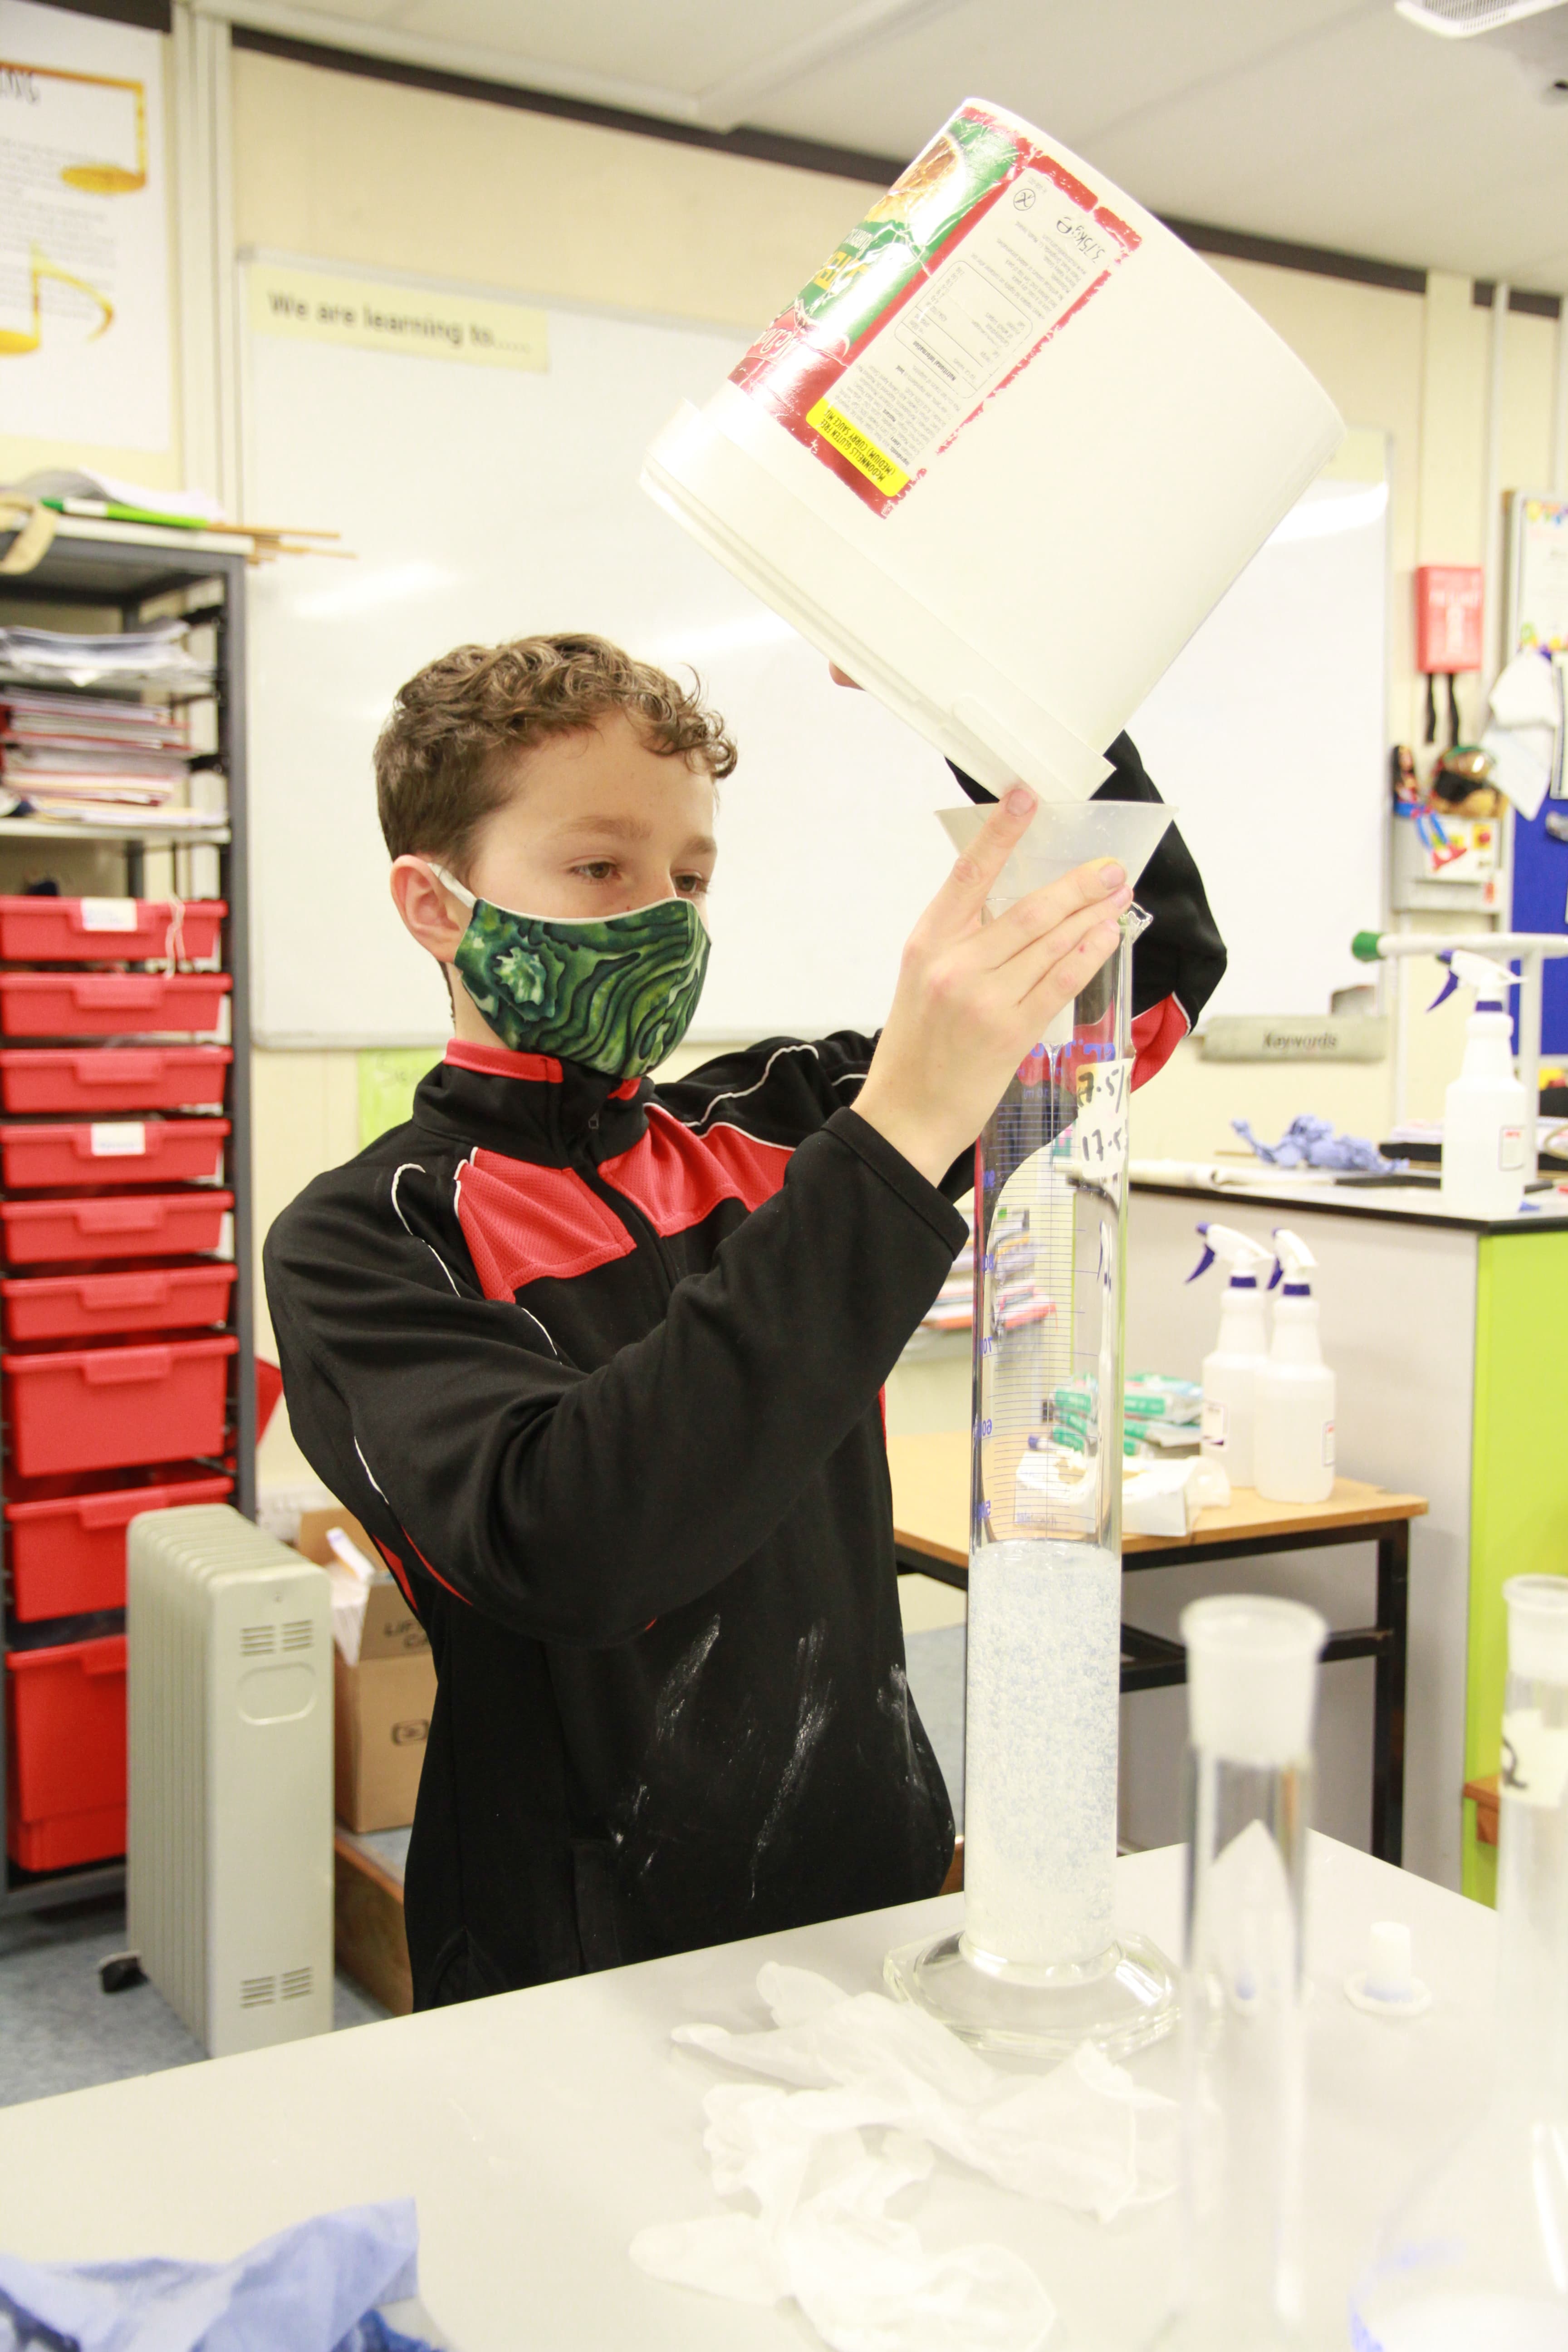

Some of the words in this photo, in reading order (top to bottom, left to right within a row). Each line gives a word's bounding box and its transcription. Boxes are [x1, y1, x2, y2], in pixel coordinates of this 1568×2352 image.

[267, 290, 308, 318] We
[316, 303, 356, 326] are
[363, 305, 465, 348] learning
[911, 340, 936, 363] Information
[933, 360, 956, 381] Nutritional
[818, 417, 834, 434] FREE
[832, 416, 852, 436] SAUCE
[829, 428, 853, 451] GLUTEN
[847, 431, 869, 452] CURRY
[848, 446, 887, 482] McDONNELLS
[864, 446, 897, 477] (MEDIUM)
